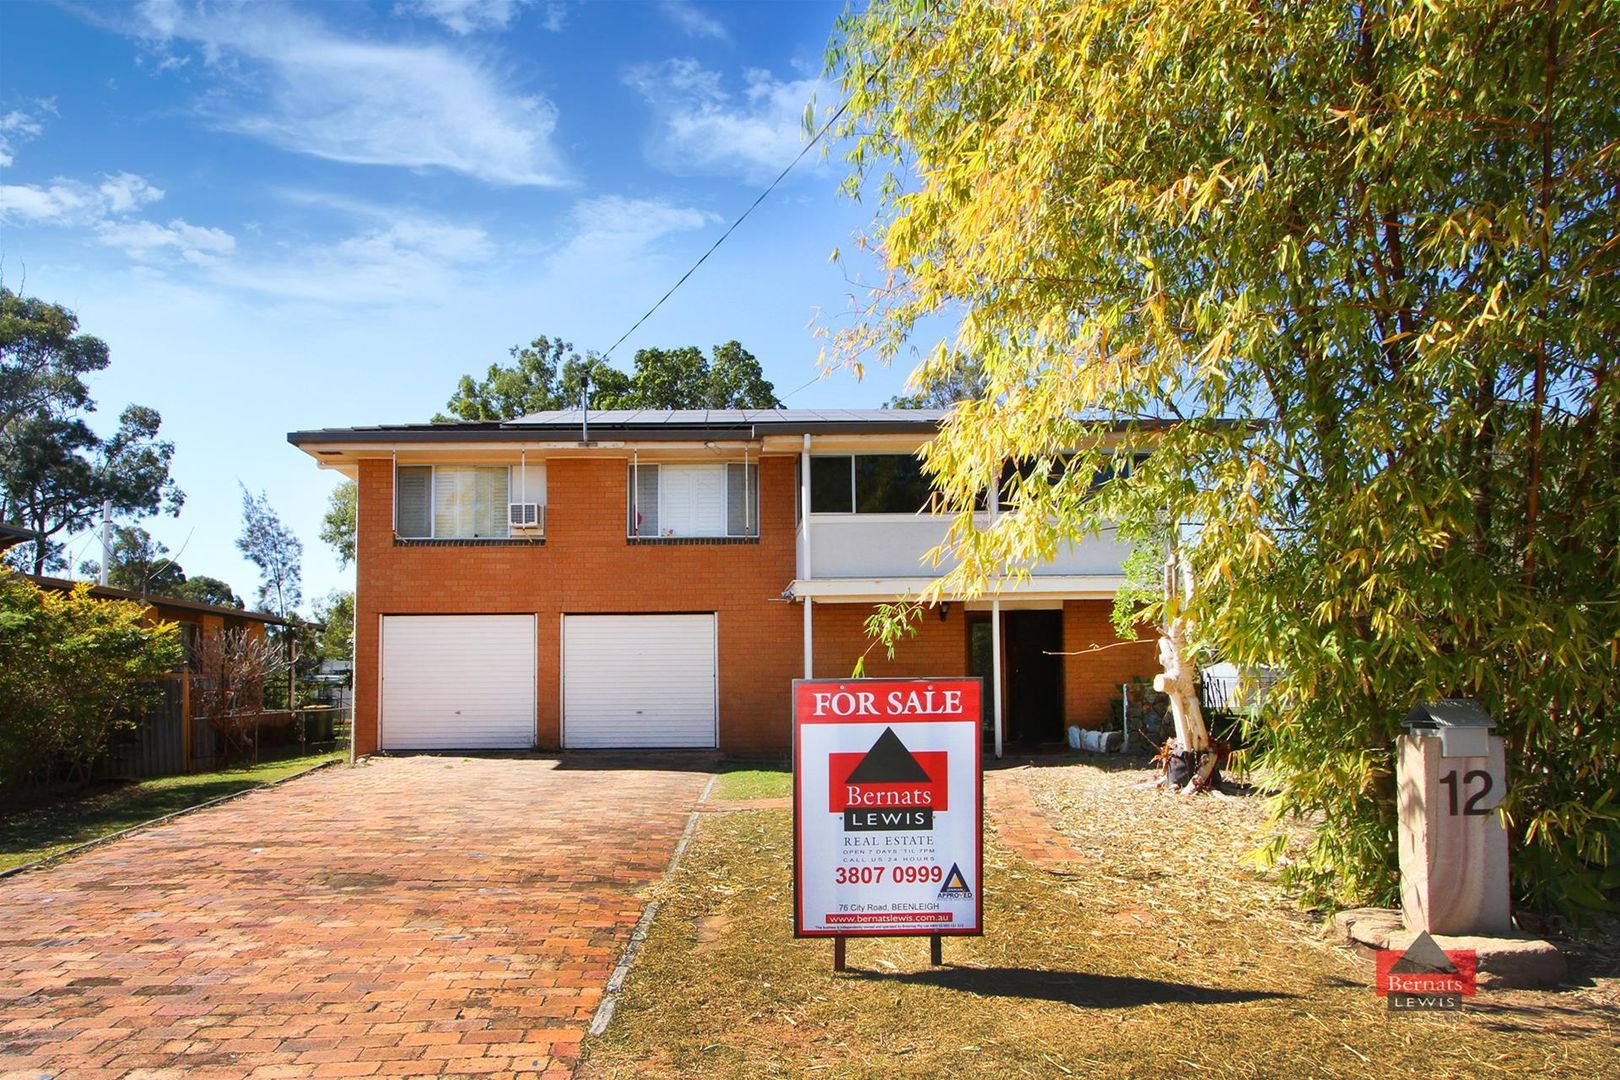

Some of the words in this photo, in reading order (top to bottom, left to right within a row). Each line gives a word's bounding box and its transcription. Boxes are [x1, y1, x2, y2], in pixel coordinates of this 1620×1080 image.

[813, 692, 880, 716] FOR
[887, 690, 963, 715] SALE
[846, 785, 932, 806] Bernats
[1439, 770, 1494, 816] 12
[852, 812, 925, 826] LEWIS
[844, 837, 879, 846] REAL
[885, 836, 934, 845] ESTATE
[835, 867, 886, 884] 3807
[892, 865, 943, 883] 0999
[850, 903, 865, 912] City
[867, 903, 890, 911] Road,
[891, 902, 940, 911] BEENLEIGH
[829, 914, 949, 923] www.bernatslewis.com.au
